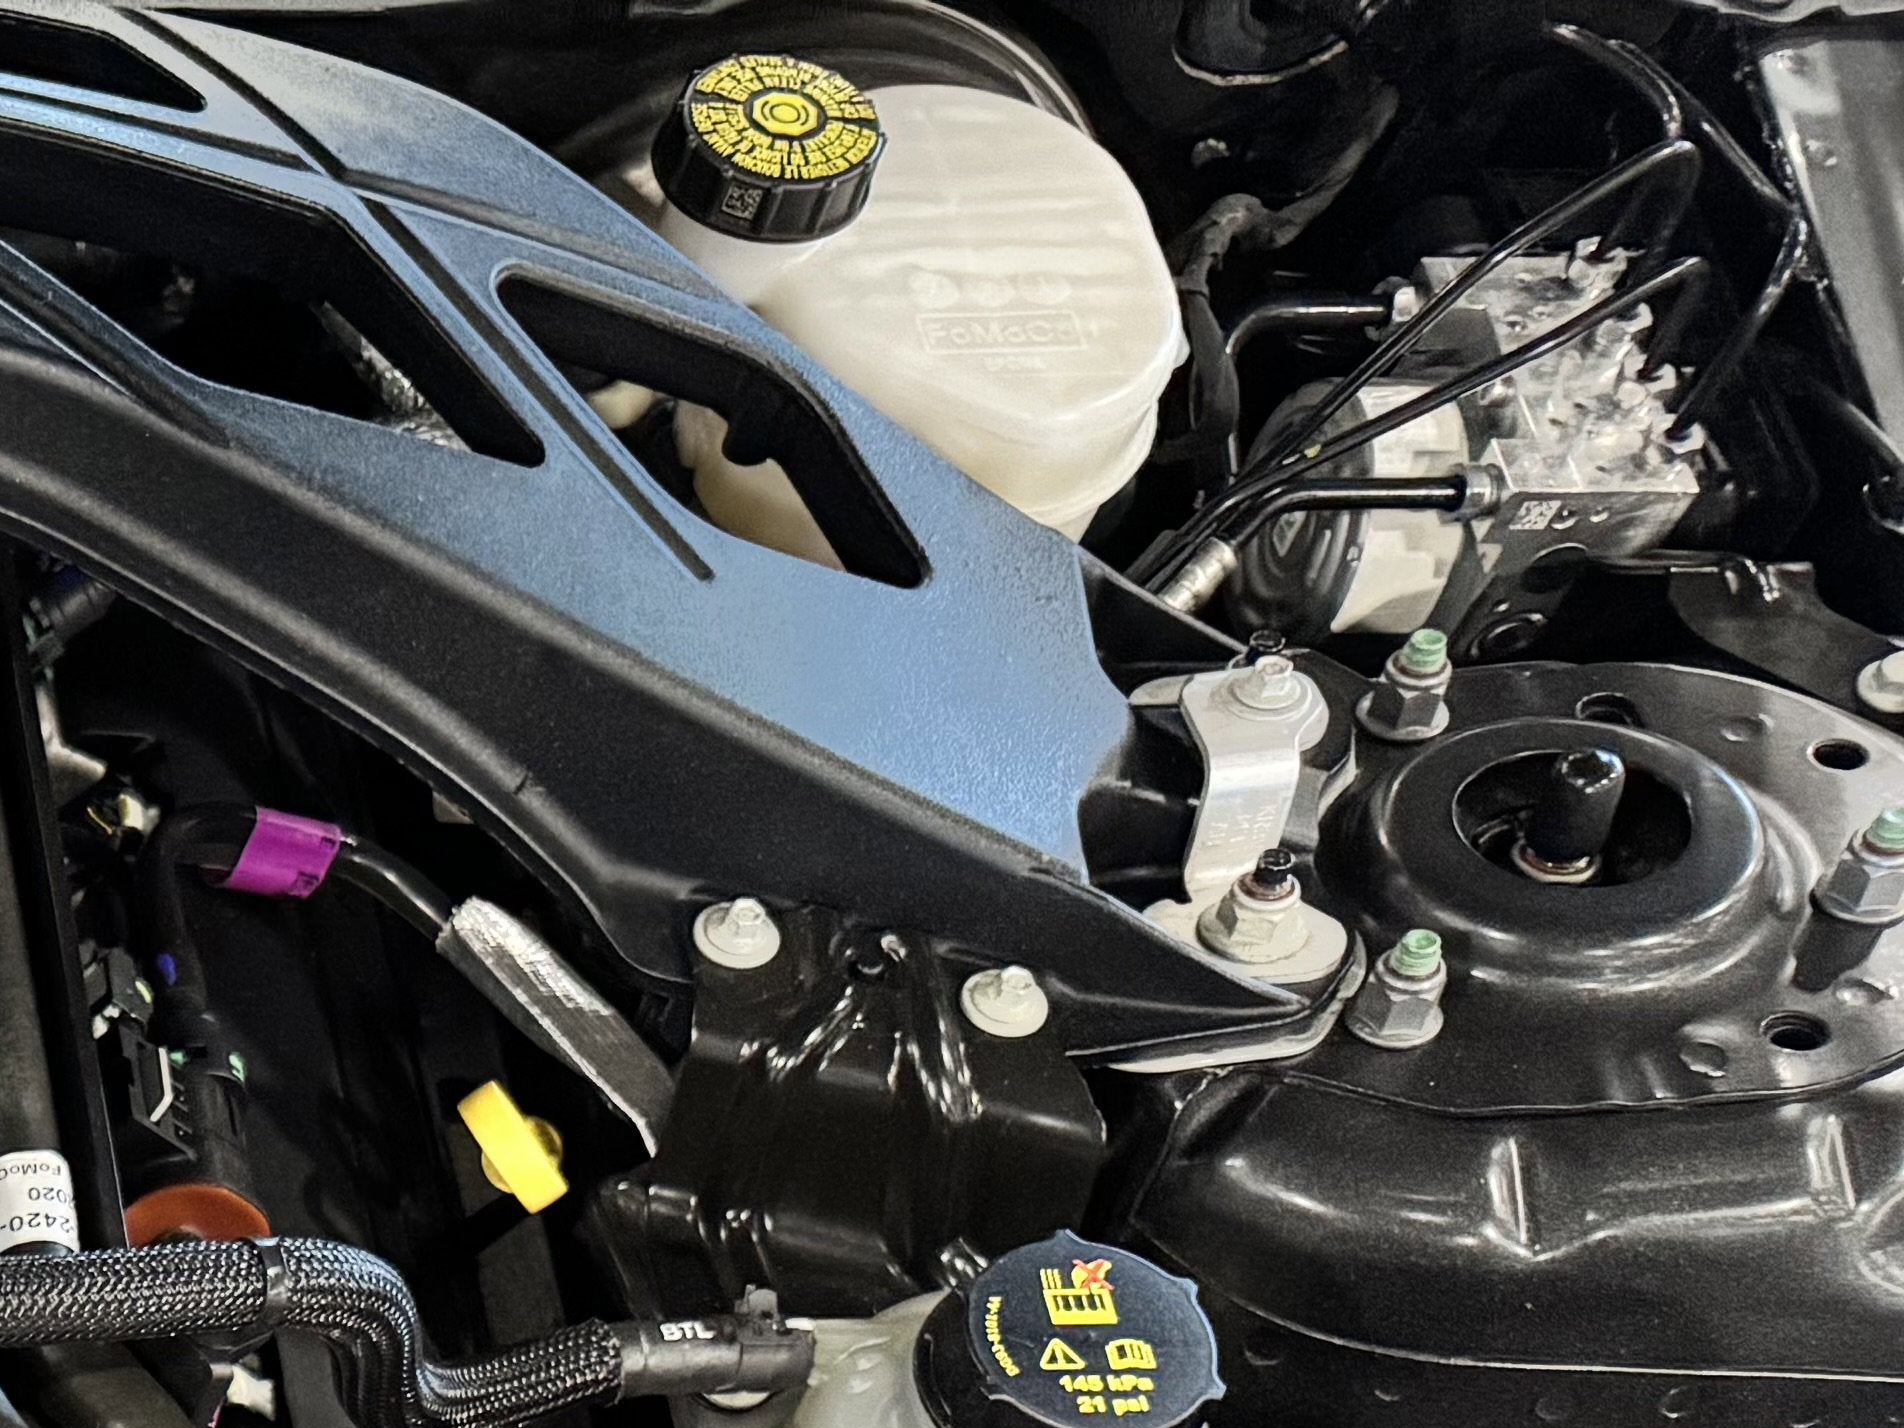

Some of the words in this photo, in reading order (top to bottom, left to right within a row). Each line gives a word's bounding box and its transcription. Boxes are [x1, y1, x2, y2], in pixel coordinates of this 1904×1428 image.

[659, 1320, 717, 1341] BTL
[1059, 1374, 1104, 1393] 145
[1106, 1374, 1155, 1392] kPa
[1076, 1396, 1108, 1414] 21
